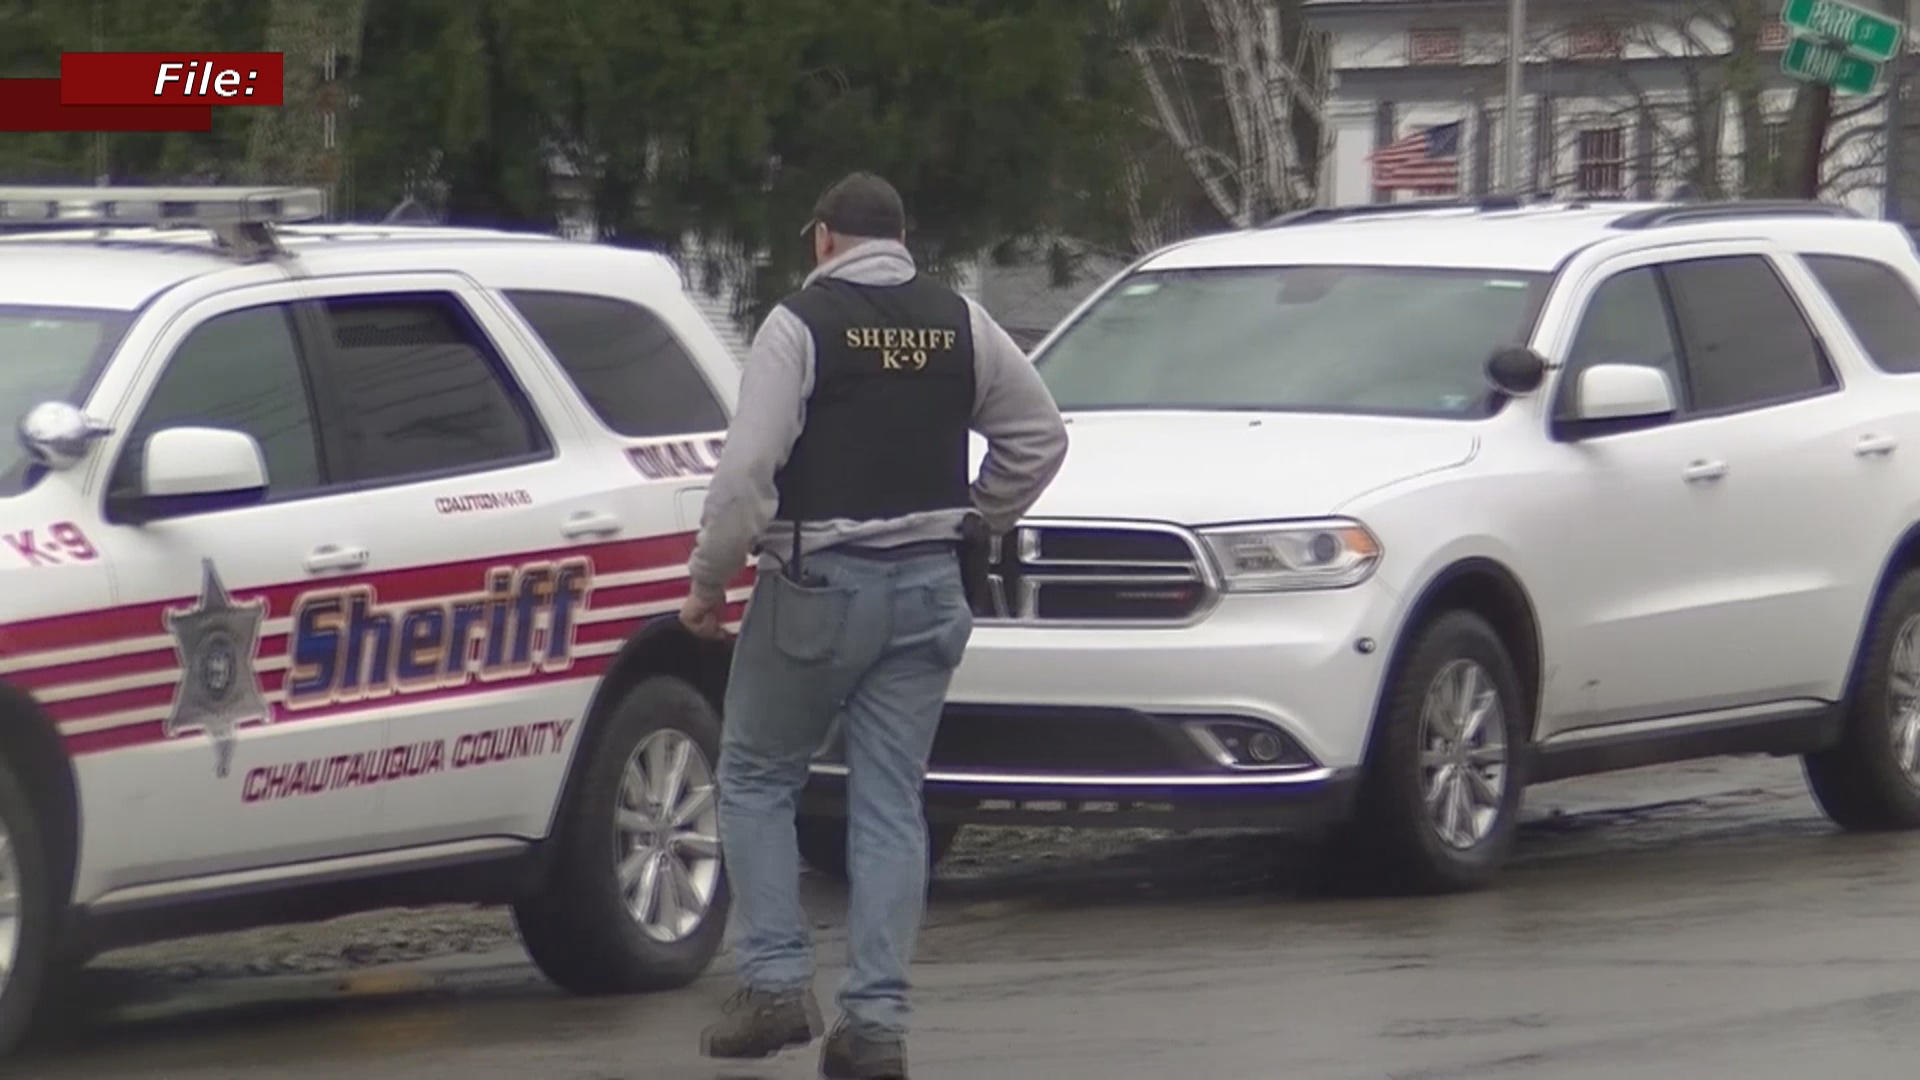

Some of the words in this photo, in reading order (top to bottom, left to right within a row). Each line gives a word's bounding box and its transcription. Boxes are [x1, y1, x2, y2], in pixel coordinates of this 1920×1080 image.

[846, 327, 956, 349] SHERIFF
[882, 349, 927, 370] K-9
[3, 521, 98, 567] K-9
[287, 556, 593, 711] Sheriff
[450, 719, 574, 768] COUNTY
